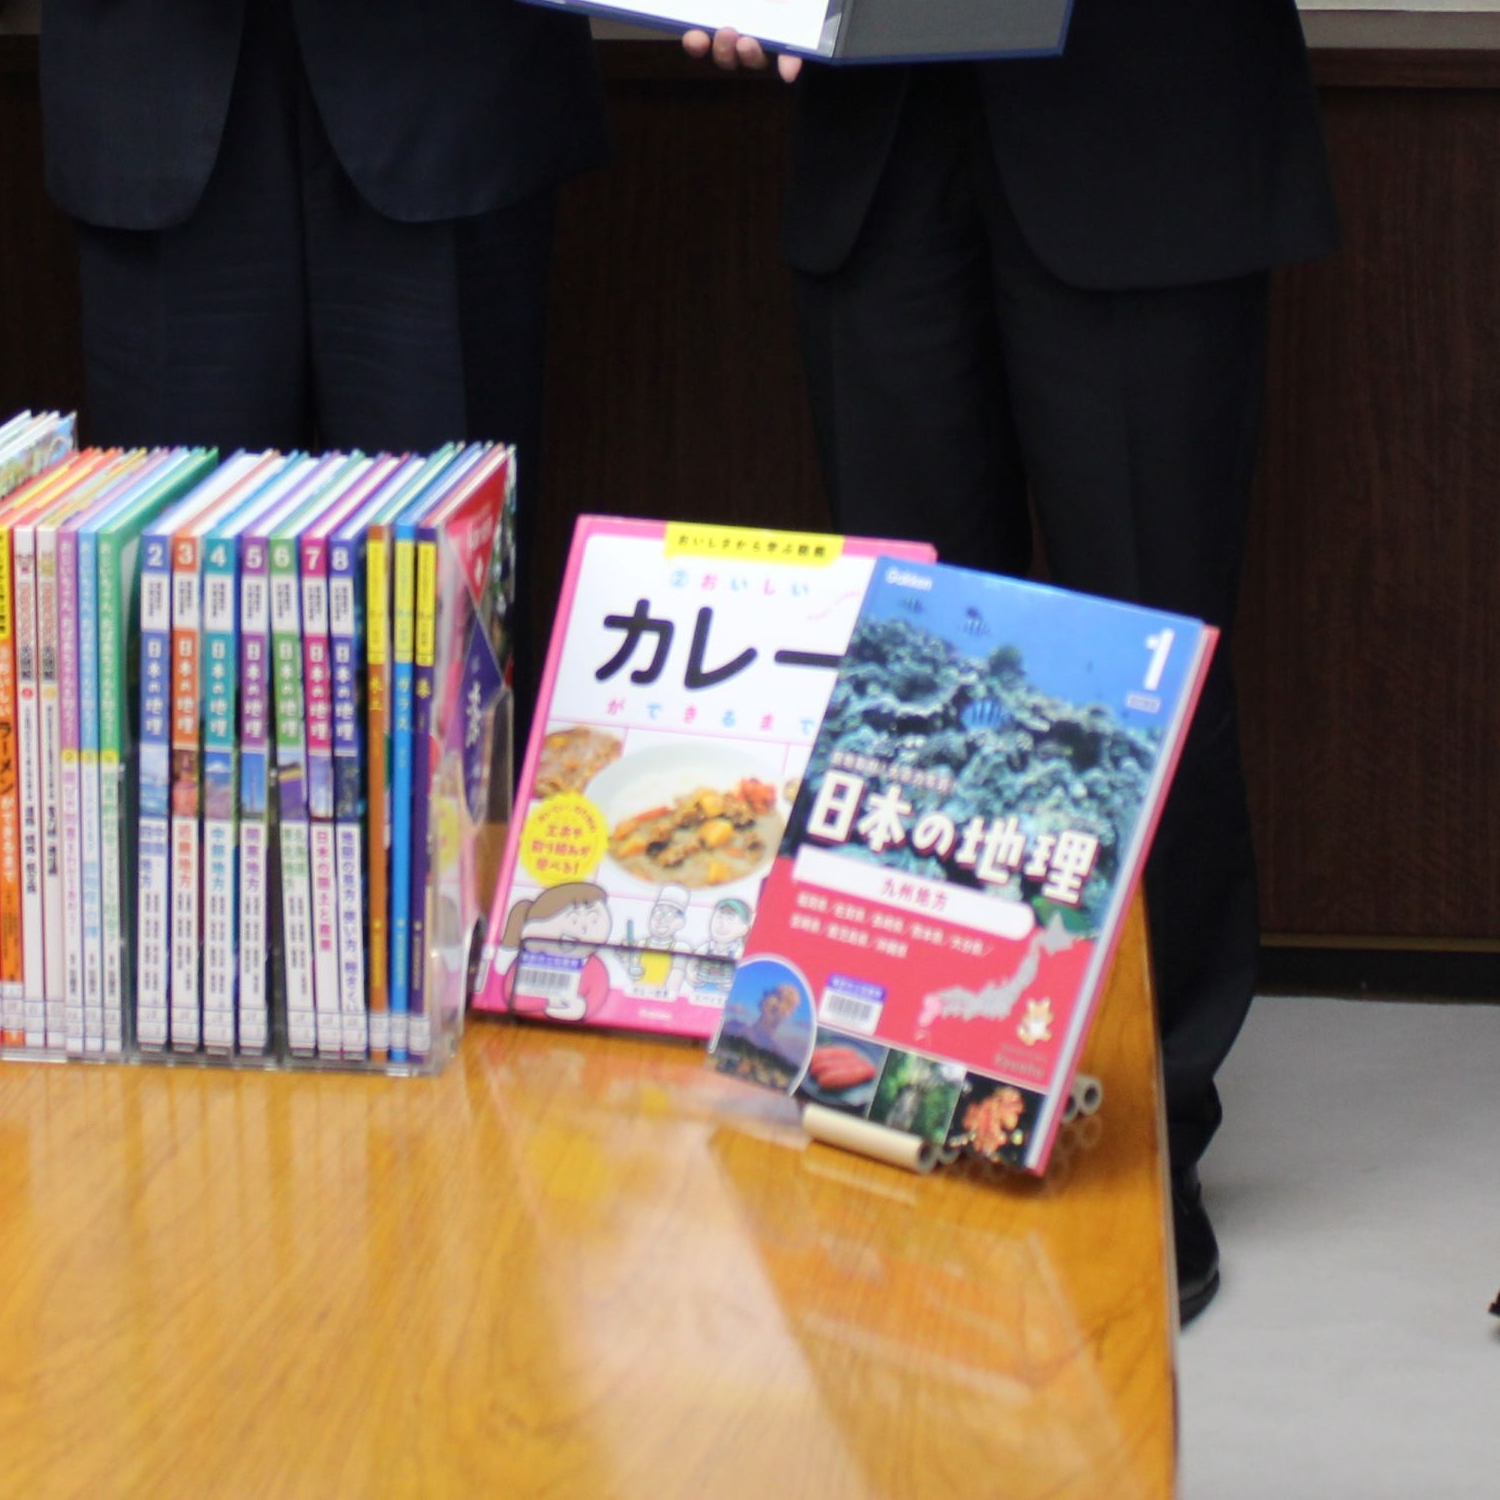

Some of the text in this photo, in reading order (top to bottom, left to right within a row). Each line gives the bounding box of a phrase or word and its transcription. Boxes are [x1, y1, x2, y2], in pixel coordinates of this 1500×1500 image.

[148, 543, 163, 567] 2
[179, 542, 193, 565] 3
[210, 545, 226, 567] 4
[246, 546, 262, 569] 5
[273, 546, 289, 568] 6
[305, 548, 321, 571] 7
[332, 547, 349, 571] 8
[677, 533, 827, 558] おいしさから学ぶ図鑑
[885, 568, 933, 591] Gakken
[596, 598, 842, 690] カレー
[1146, 628, 1175, 692] 1
[145, 638, 163, 736] 日本の地理
[176, 637, 194, 735] 日本の地理
[210, 639, 228, 737] 日本の地理
[245, 641, 262, 738] 日本の地理
[280, 639, 298, 738] 日本の地理
[309, 642, 328, 741] 日本の地理
[335, 642, 354, 741] 日本の地理
[606, 697, 814, 736] ができるまで
[807, 769, 1099, 907] 日本の地理
[880, 874, 948, 911] 九州地方
